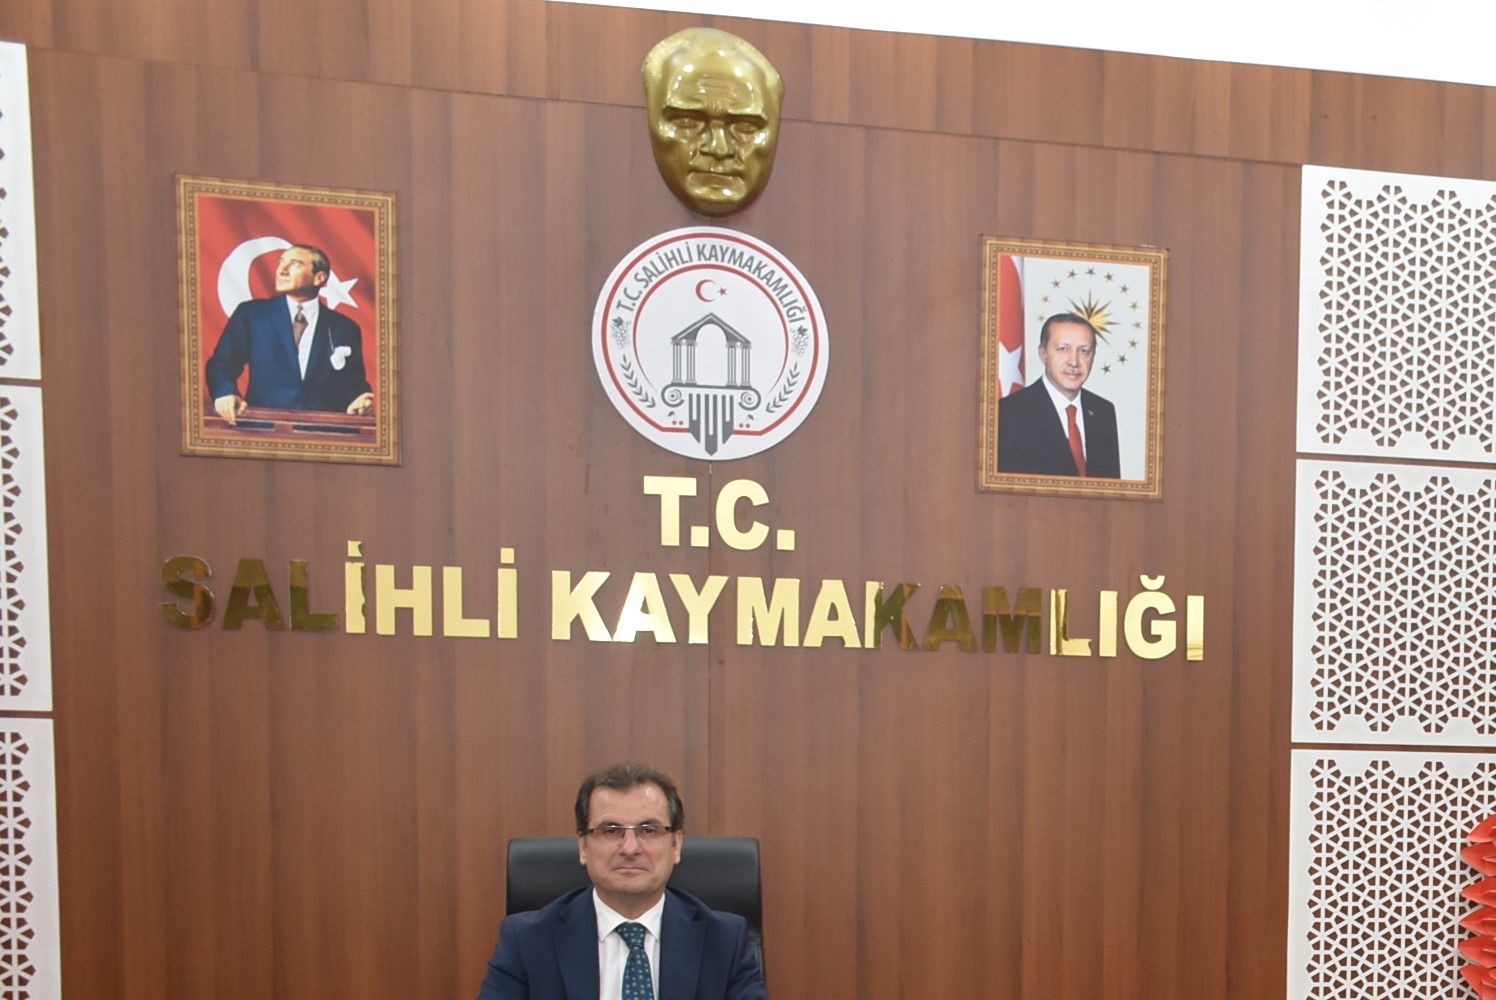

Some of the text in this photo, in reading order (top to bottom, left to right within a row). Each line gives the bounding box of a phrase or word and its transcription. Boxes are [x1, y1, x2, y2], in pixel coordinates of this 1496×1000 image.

[616, 241, 807, 323] T.C. SALİHLİ KAYMAKAMLIĞI
[644, 476, 795, 550] T.C.
[160, 540, 1204, 660] SALİHLİ KAYMAKAMLIĞI
